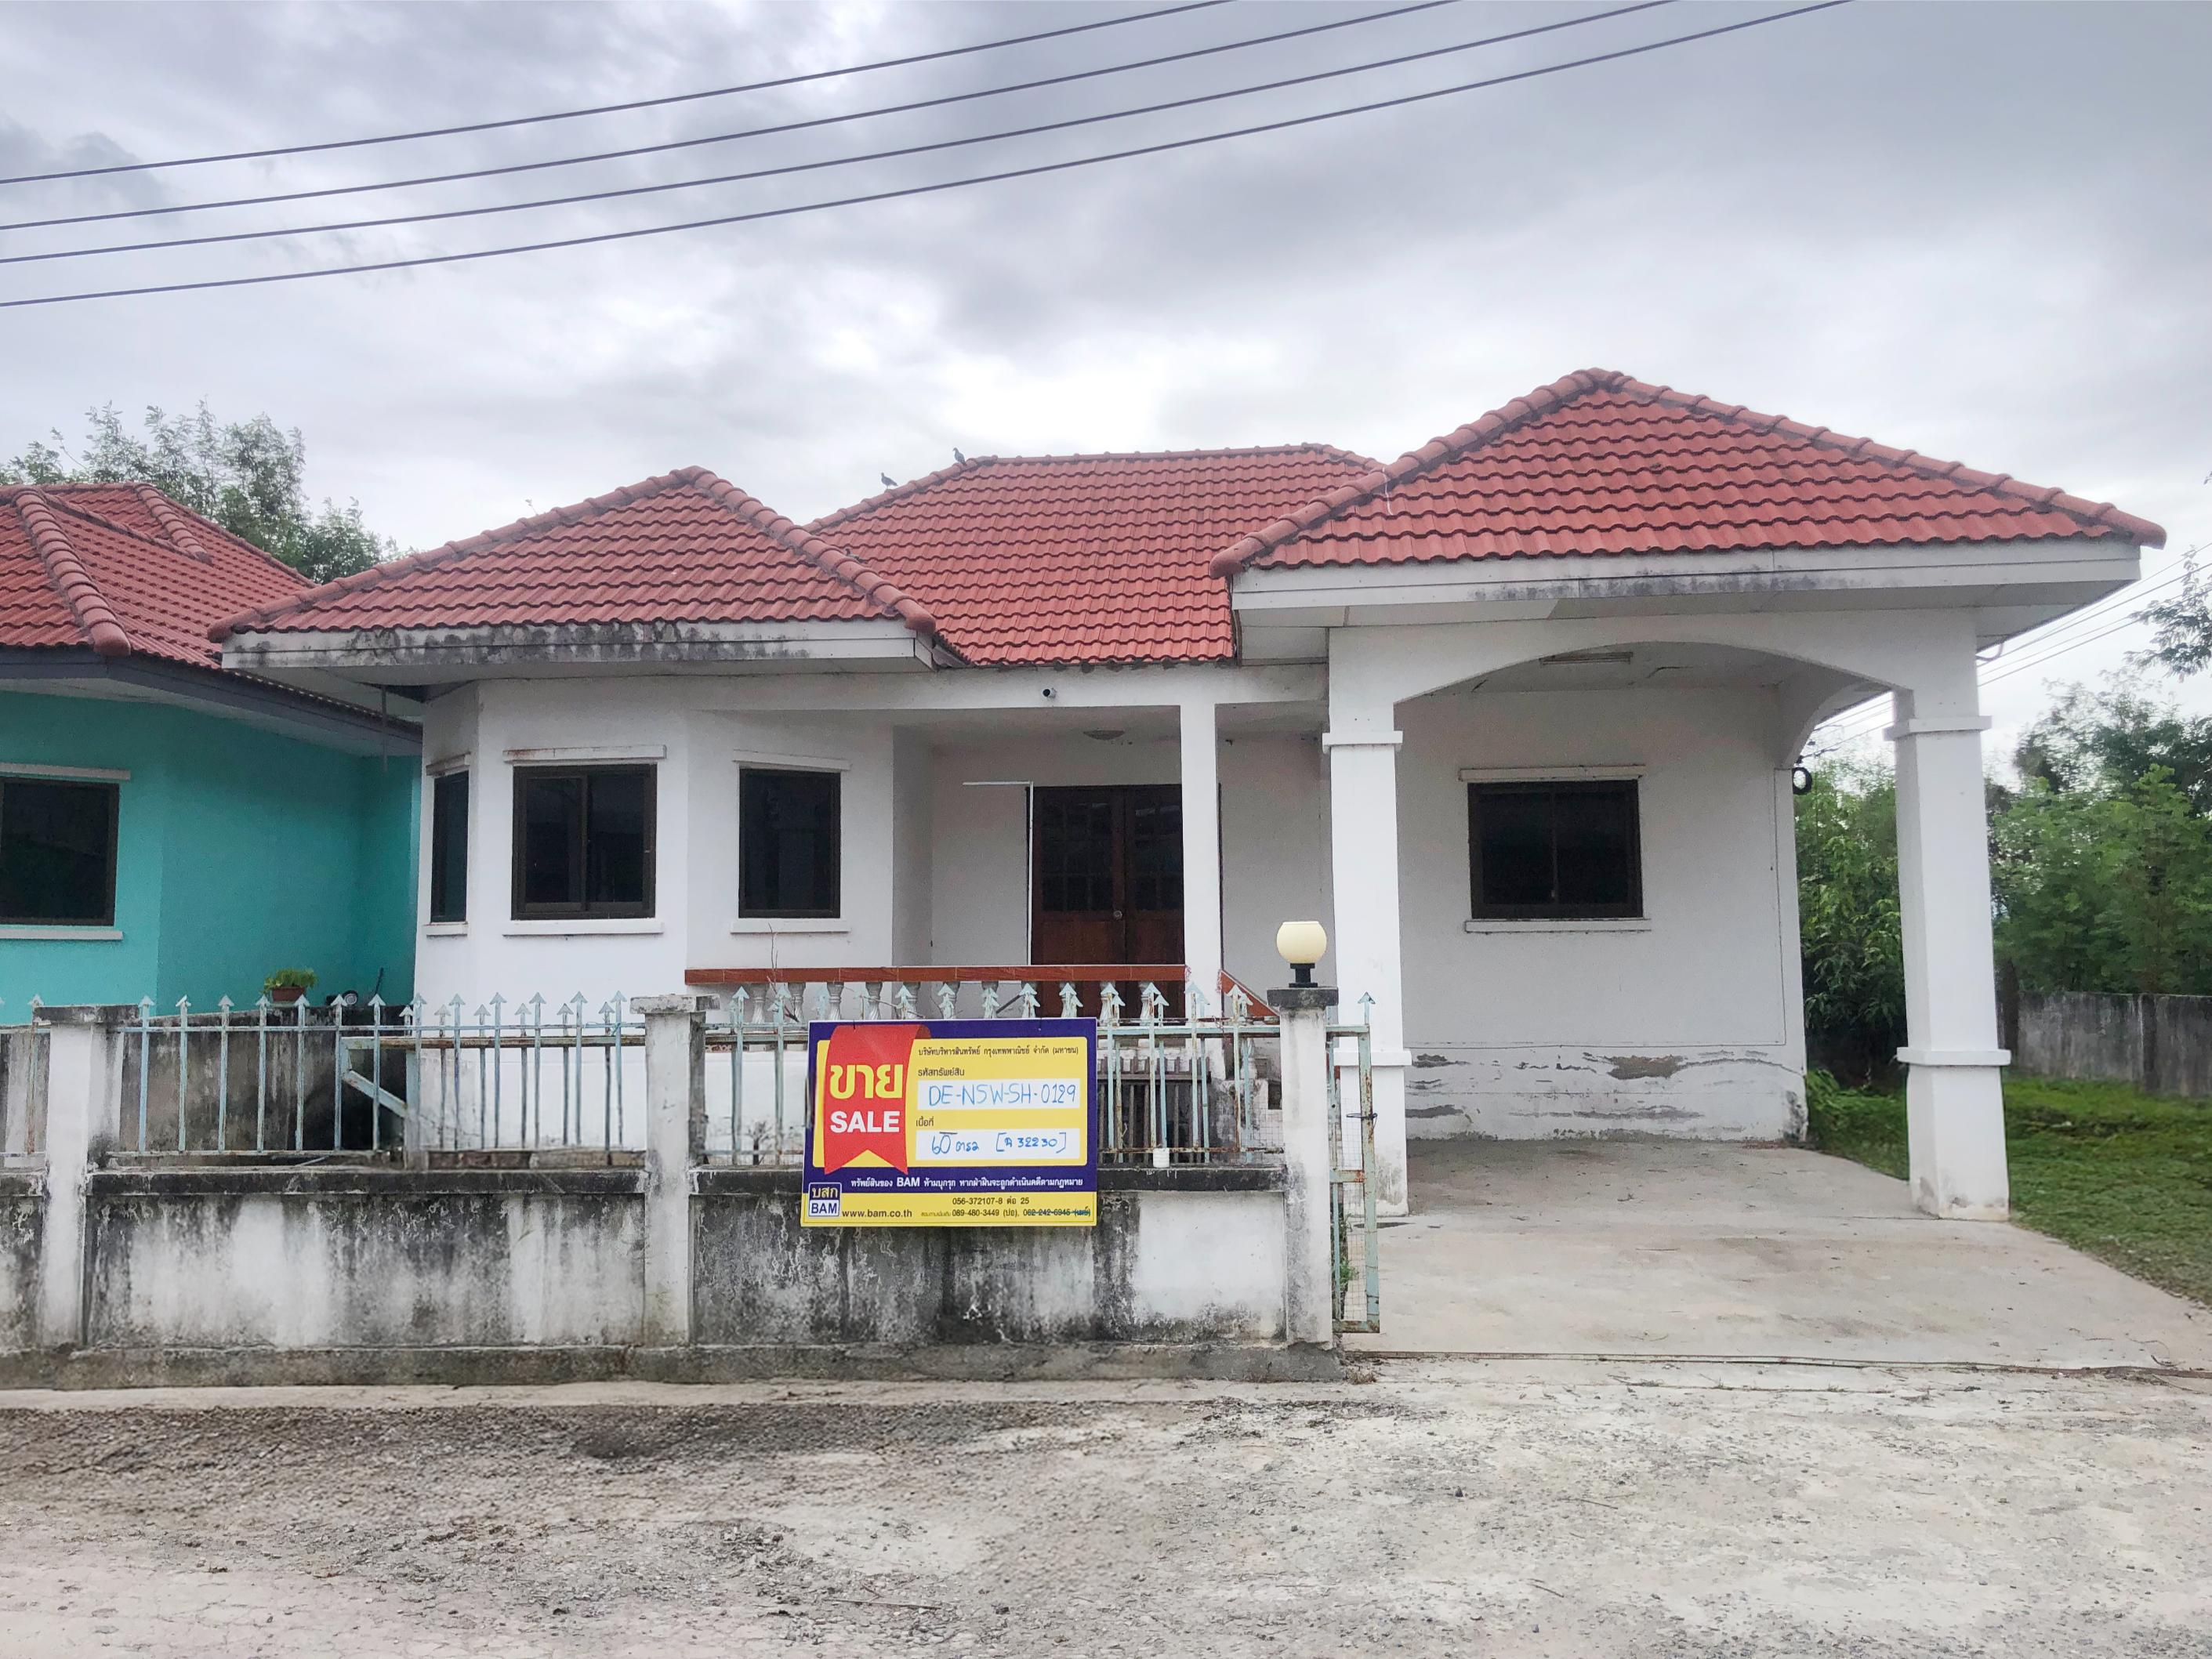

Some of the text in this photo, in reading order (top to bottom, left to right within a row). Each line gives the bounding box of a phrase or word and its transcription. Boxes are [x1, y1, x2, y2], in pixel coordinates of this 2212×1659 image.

[918, 1045, 1079, 1058] บริษัทบริหารสินทรัพย์ กรุงเทพพาณิชย์ จำกัด (มหาชน)
[917, 1067, 965, 1077] รหัสทรัพย์สิน
[829, 1063, 904, 1099] ขาย
[830, 1110, 901, 1134] SALE
[916, 1115, 934, 1127] เนื้อที่
[850, 1177, 894, 1187] ทรัพย์สินของ
[896, 1176, 920, 1187] BAM
[923, 1177, 956, 1190] ห้ามบุกรุก
[811, 1186, 839, 1199] บสก
[952, 1197, 1003, 1205] 056-372107-8
[1006, 1195, 1017, 1204] ต่อ
[810, 1202, 838, 1215] BAM
[842, 1208, 912, 1218] www.bam.co.th
[952, 1208, 999, 1217] 089-480-3449
